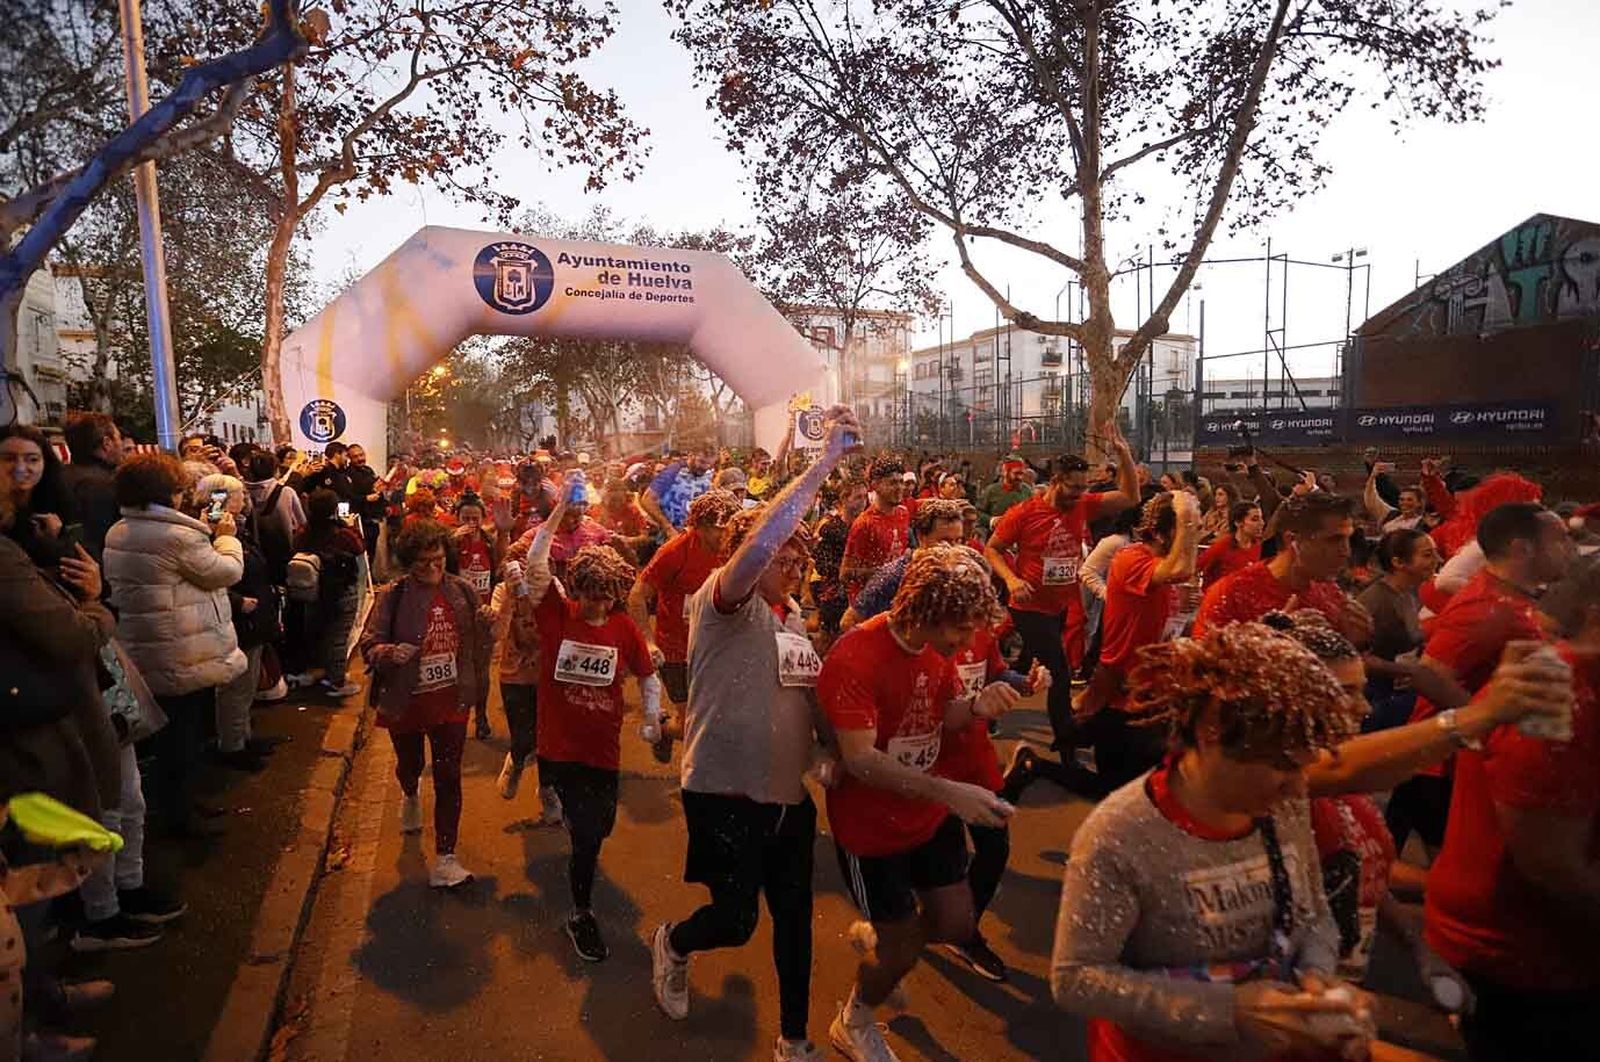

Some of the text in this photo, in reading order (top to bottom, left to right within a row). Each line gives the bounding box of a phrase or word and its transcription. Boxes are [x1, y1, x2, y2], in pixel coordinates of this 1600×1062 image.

[557, 252, 691, 274] Ayuntamiento
[597, 271, 693, 290] de Huelva
[628, 291, 643, 301] de
[645, 292, 694, 304] Deportes
[1379, 413, 1434, 426] HYUNDAI
[1476, 408, 1544, 422] HYUNDAI
[1287, 419, 1332, 429] HYUNDAI
[1058, 565, 1075, 577] 320
[579, 656, 610, 675] 448
[797, 650, 820, 673] 449
[426, 664, 452, 681] 398
